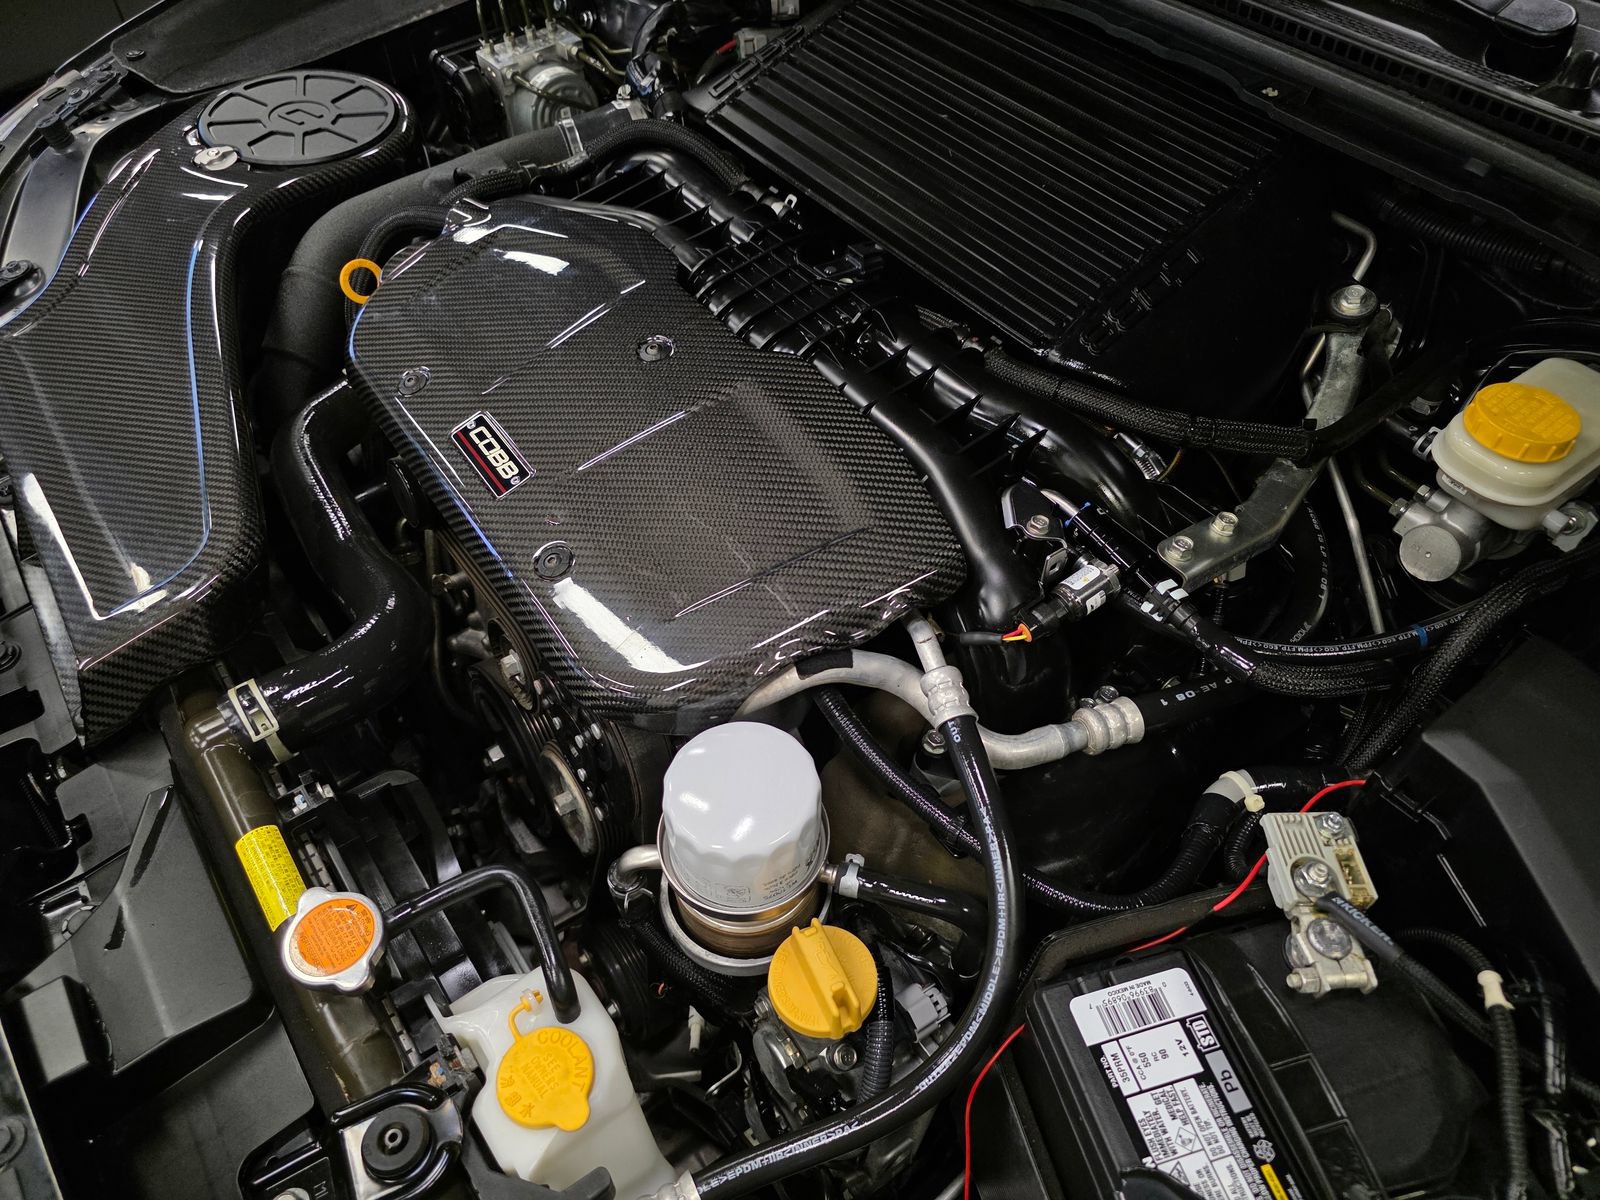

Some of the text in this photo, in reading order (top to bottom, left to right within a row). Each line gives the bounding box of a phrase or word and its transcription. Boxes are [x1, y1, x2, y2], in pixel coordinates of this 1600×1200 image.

[469, 426, 519, 479] COBB
[1175, 689, 1195, 701] 08
[1199, 681, 1217, 692] AE
[947, 719, 961, 743] OUT
[1107, 986, 1128, 996] MEXICO
[1129, 985, 1153, 999] 83996
[1135, 979, 1151, 988] MADE
[1101, 993, 1126, 1006] 06895
[1191, 1018, 1215, 1047] STD
[1151, 1051, 1159, 1061] RC
[1158, 1048, 1169, 1059] 90
[1175, 1037, 1189, 1056] 12V
[537, 1030, 587, 1092] COOLANT
[542, 1052, 560, 1072] SEE
[1110, 1052, 1130, 1083] 35PRM
[1138, 1051, 1151, 1068] 550
[520, 1062, 548, 1098] MANUAL
[1099, 1055, 1118, 1088] PART NO.
[1135, 1065, 1146, 1080] CCA
[1220, 1070, 1239, 1094] Pb
[1150, 1091, 1162, 1105] GET
[1158, 1089, 1177, 1120] MEDICAL
[1166, 1086, 1189, 1125] HELP FAST.
[1151, 1107, 1178, 1155] WITH WATER.
[1193, 1115, 1205, 1132] OPEN
[1136, 1117, 1163, 1161] FLUSH EYES
[1142, 1109, 1170, 1158] IMMEDIATELY
[1201, 1133, 1212, 1145] NOT
[1209, 1131, 1219, 1143] NOT
